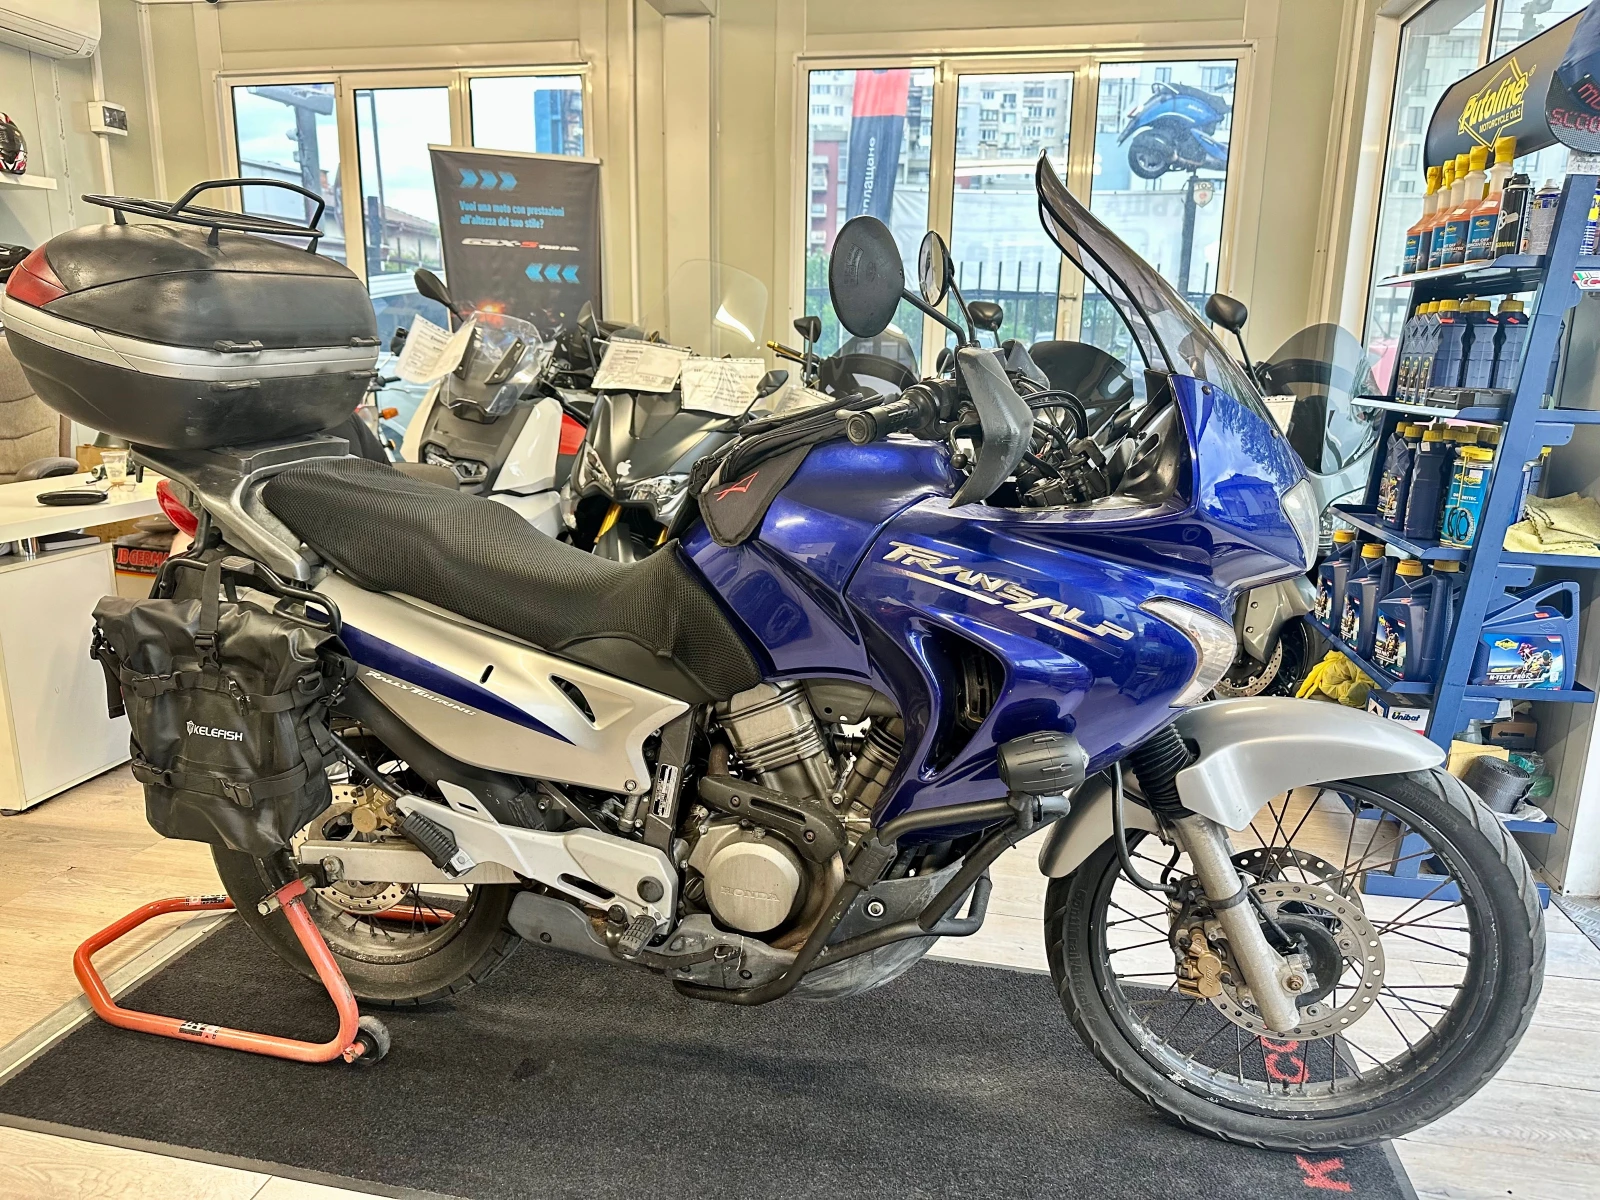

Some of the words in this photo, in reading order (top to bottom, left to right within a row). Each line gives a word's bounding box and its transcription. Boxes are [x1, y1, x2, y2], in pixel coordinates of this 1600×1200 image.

[1479, 112, 1509, 133] MOTORCYCLE
[1510, 107, 1521, 119] OILS
[459, 200, 477, 212] Vuoi
[478, 203, 491, 212] una
[492, 204, 511, 213] moto
[512, 206, 526, 214] con
[526, 206, 565, 217] prestazioni
[510, 218, 523, 227] suo
[882, 540, 1135, 641] TRANSALP
[1391, 711, 1421, 722] Unibat
[193, 724, 244, 742] KELEFISH
[721, 885, 781, 902] HONDA
